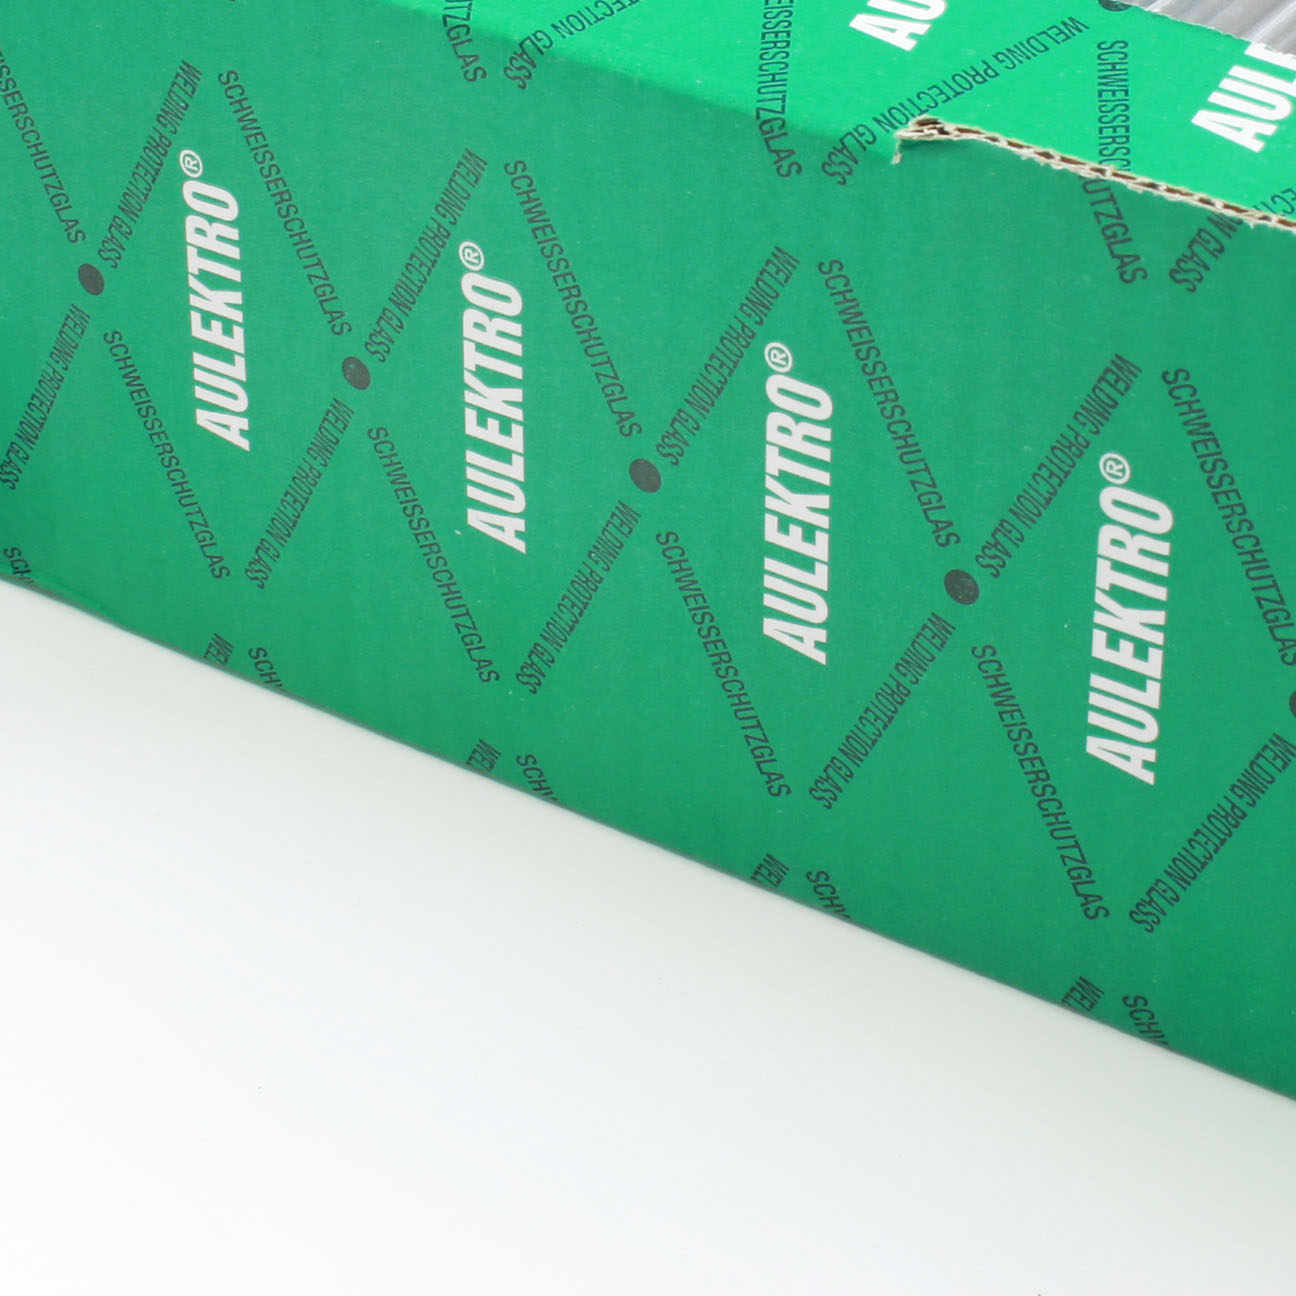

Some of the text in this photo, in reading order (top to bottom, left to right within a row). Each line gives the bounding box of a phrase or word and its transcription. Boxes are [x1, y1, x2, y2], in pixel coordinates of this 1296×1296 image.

[503, 30, 553, 90] GLASS
[821, 17, 1089, 186] WELDING PROTECTION GLASS
[97, 60, 202, 269] WELDING PROTECTION GLASS
[218, 70, 353, 336] SCHWEISSERSCHUTZGLAS
[50, 304, 90, 371] WELDING
[364, 149, 488, 363] WELDING PROTECTION GLASS
[503, 160, 643, 437] SCHWEISSERSCHUTZGLAS
[1168, 228, 1226, 294] GLASS
[15, 363, 64, 450] PROTECTION
[656, 246, 800, 466] WELDING PROTECTION GLASS
[817, 259, 961, 548] SCHWEISSERSCHUTZGLAS
[103, 330, 231, 579] SCHWEISSERSCHUTZGLAS
[245, 398, 350, 589] WELDING PROTECTION GLASS
[587, 501, 641, 572] WELDING
[975, 353, 1142, 578] WELDING PROTECTION GLASS
[367, 427, 501, 683] SCHWEISSERSCHUTZGLAS
[540, 562, 604, 648] PROTECTION
[516, 642, 555, 694] GLASS
[655, 531, 792, 797] SCHWEISSERSCHUTZGLAS
[838, 674, 912, 767] PROTECTION
[894, 612, 956, 685] WELDING
[808, 756, 854, 810] GLASS
[971, 644, 1111, 920] SCHWEISSERSCHUTZGLAS
[1163, 795, 1248, 891] PROTECTION
[1129, 878, 1180, 933] GLASS
